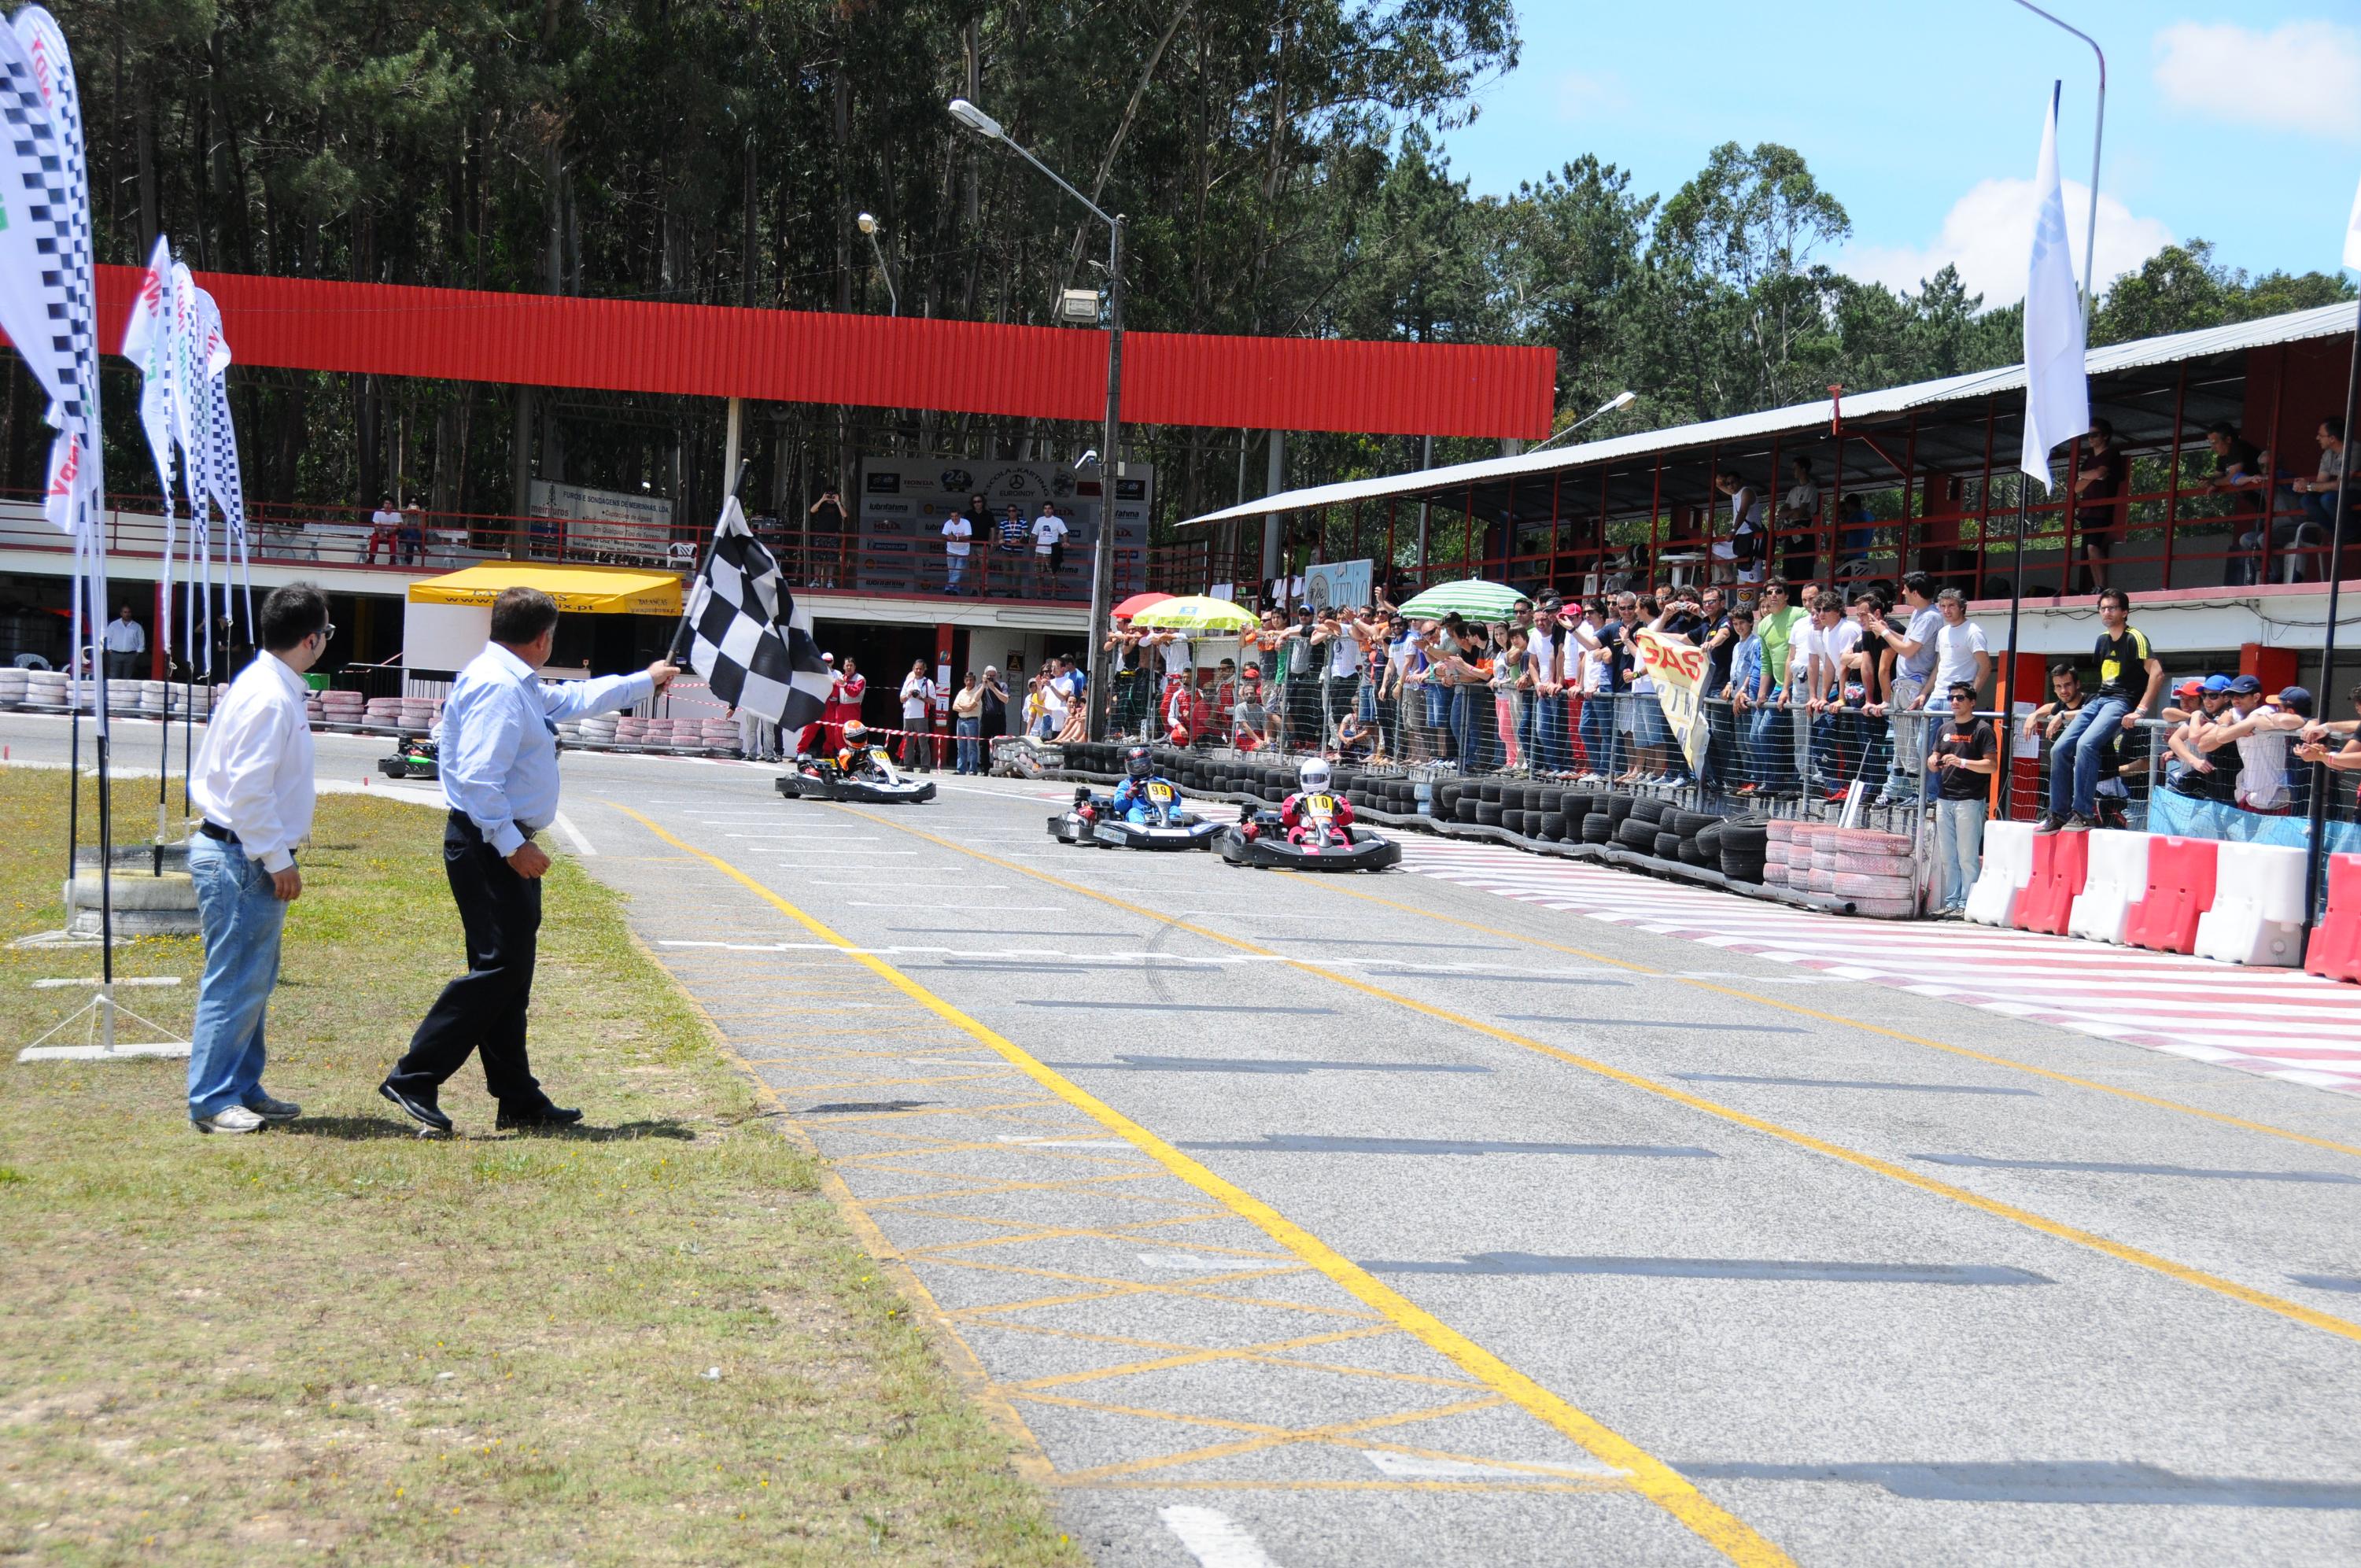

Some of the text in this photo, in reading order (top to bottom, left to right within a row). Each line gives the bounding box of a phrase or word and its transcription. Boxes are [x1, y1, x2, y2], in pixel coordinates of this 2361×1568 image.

[983, 468, 1012, 496] ESCOLA
[1017, 467, 1050, 496] KARTING
[563, 491, 581, 501] FUROS
[588, 496, 620, 507] SONDAGENS
[1152, 785, 1168, 796] 99
[1313, 797, 1329, 809] 10
